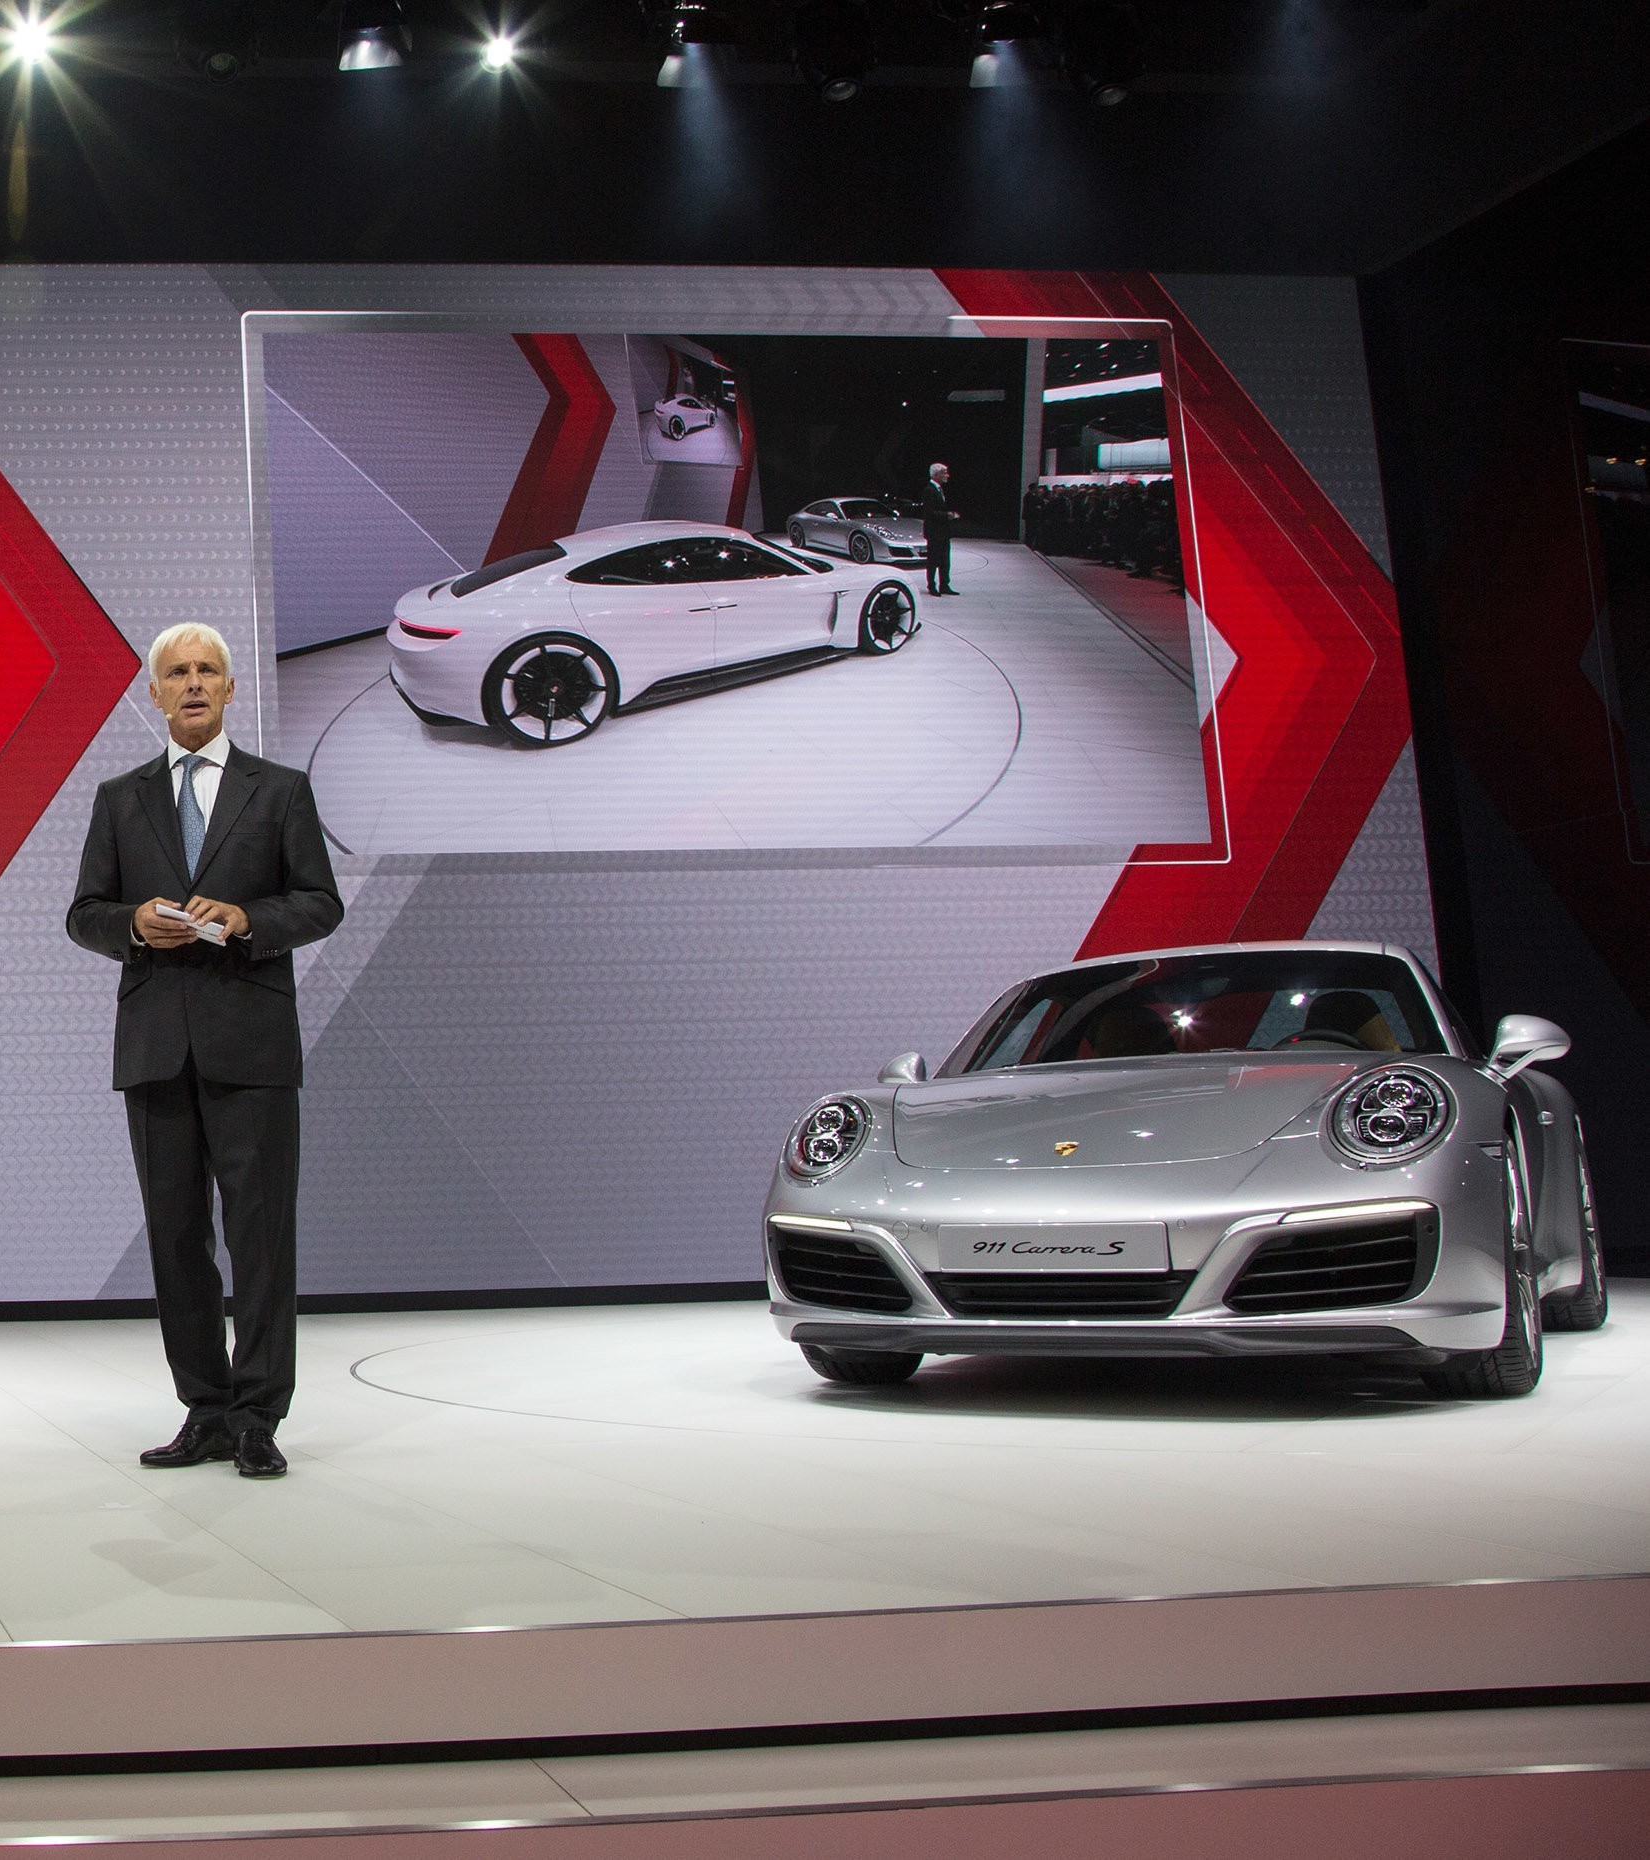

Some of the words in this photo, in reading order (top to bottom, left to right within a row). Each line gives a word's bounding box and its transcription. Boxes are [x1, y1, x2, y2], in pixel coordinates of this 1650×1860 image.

[973, 1241, 1007, 1255] 911
[1011, 1241, 1096, 1255] Carrera
[1096, 1241, 1127, 1256] S
